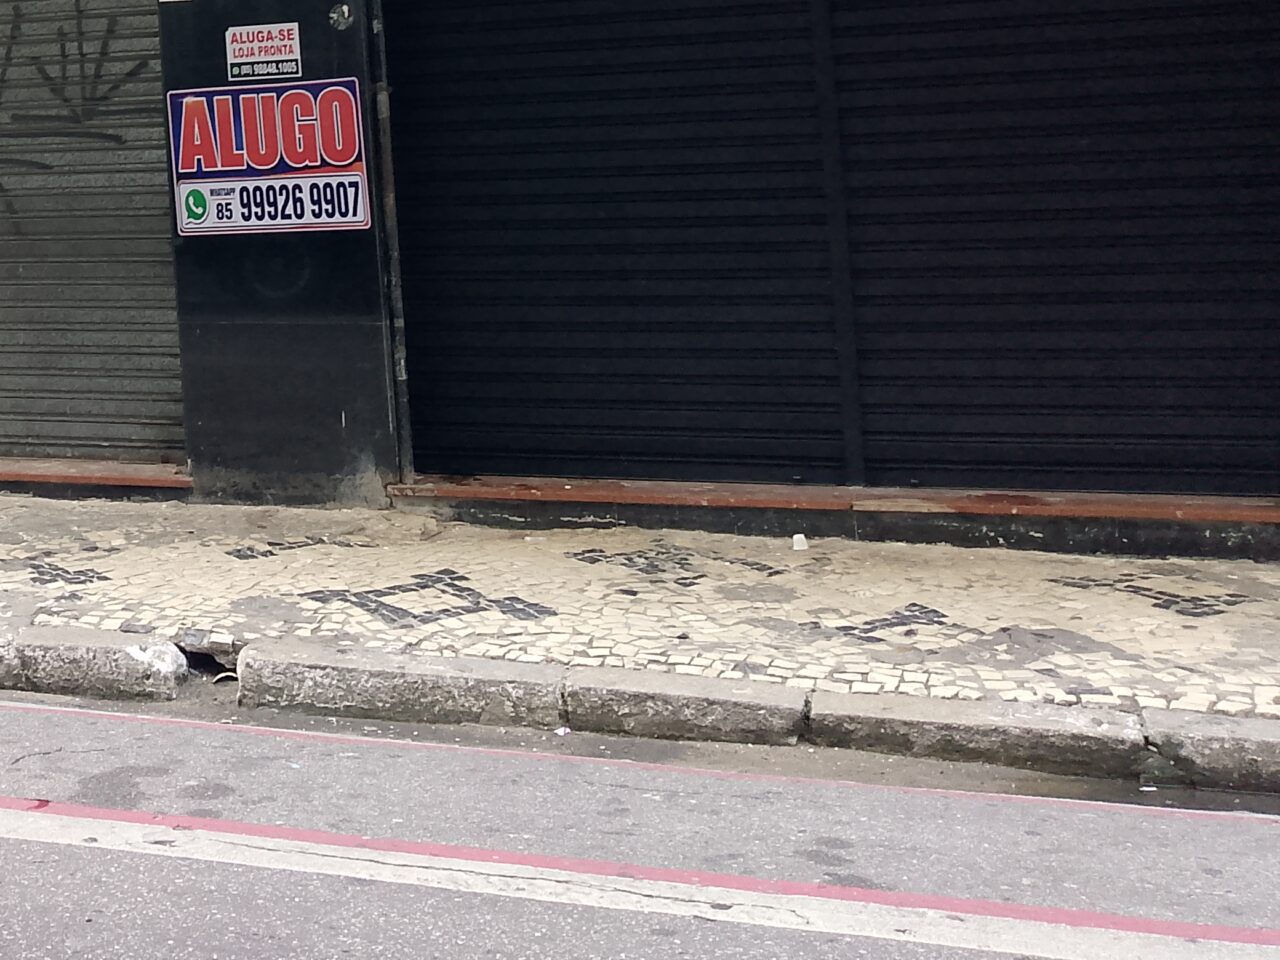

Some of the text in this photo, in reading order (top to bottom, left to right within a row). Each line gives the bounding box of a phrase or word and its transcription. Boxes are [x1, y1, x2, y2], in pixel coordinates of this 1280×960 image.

[231, 28, 295, 45] ALUGA-SE
[233, 44, 294, 58] LOJA PRONTA
[178, 86, 360, 173] ALUGO
[216, 181, 360, 222] 85 99926 9907
